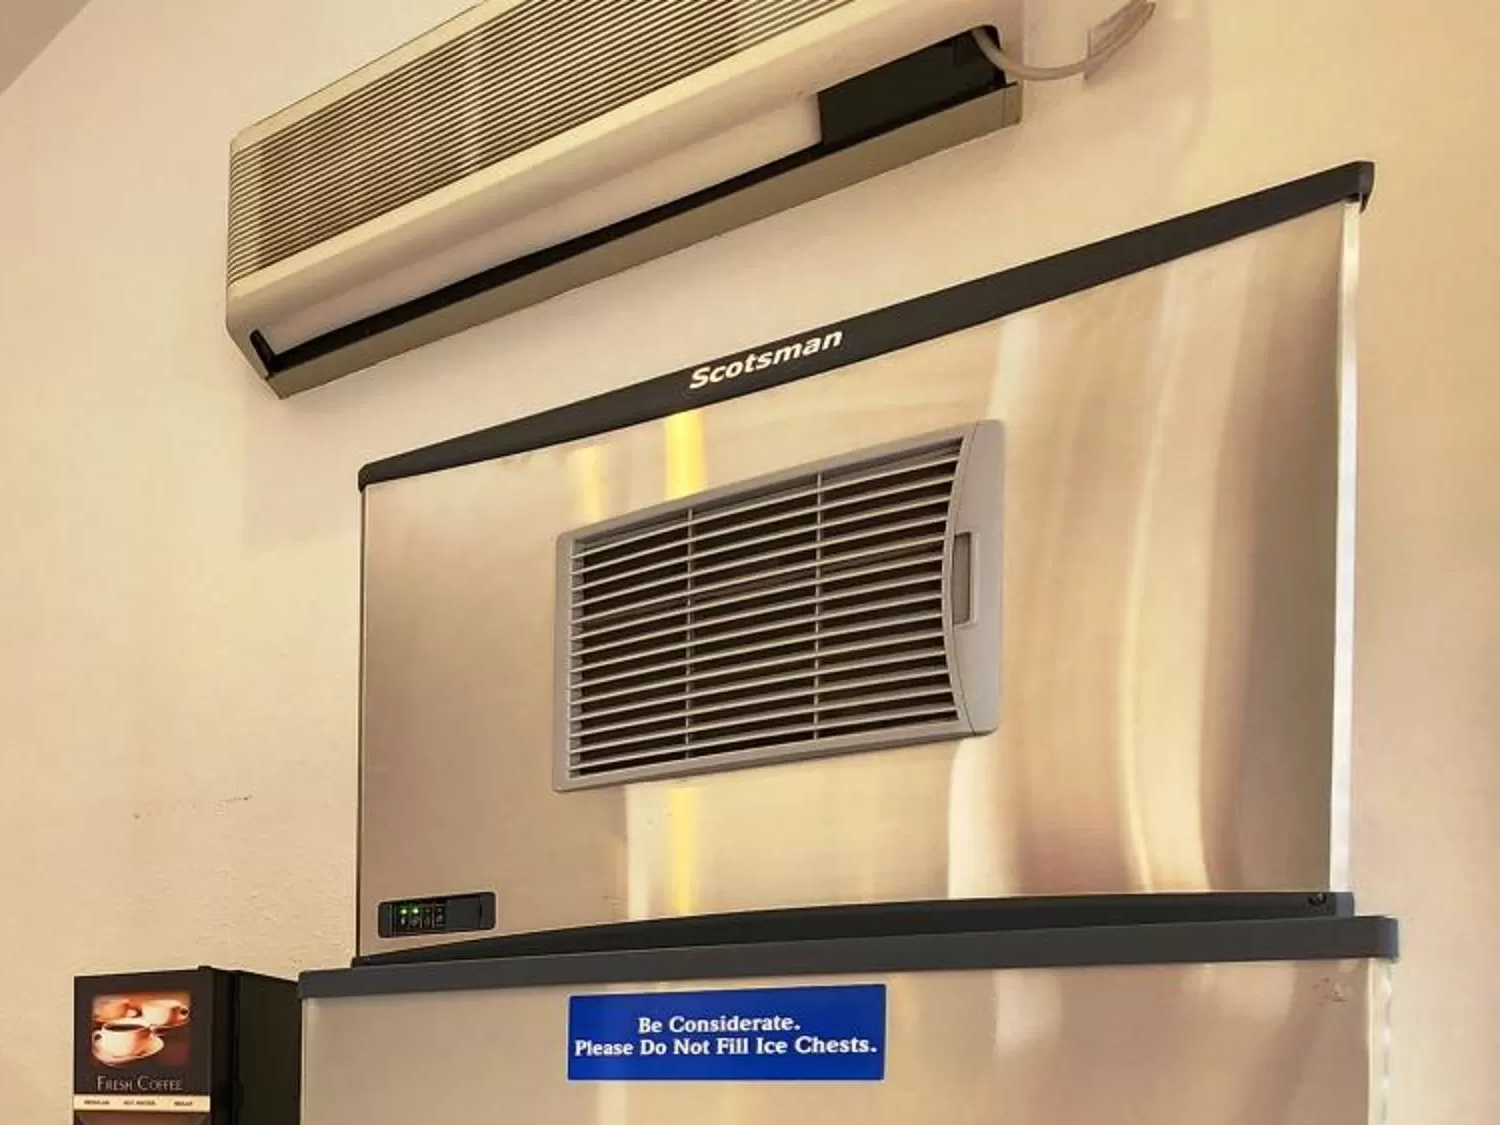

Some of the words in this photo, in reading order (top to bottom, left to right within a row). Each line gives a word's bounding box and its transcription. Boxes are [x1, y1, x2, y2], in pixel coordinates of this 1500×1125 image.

[689, 331, 843, 389] Scotsman
[638, 1017, 663, 1033] Be
[668, 1015, 801, 1033] Considerate.
[574, 1039, 634, 1056] Please
[640, 1039, 667, 1055] Do
[673, 1038, 711, 1055] Not
[716, 1037, 749, 1055] Fill
[756, 1037, 788, 1054] Ice
[795, 1036, 878, 1054] Chests.
